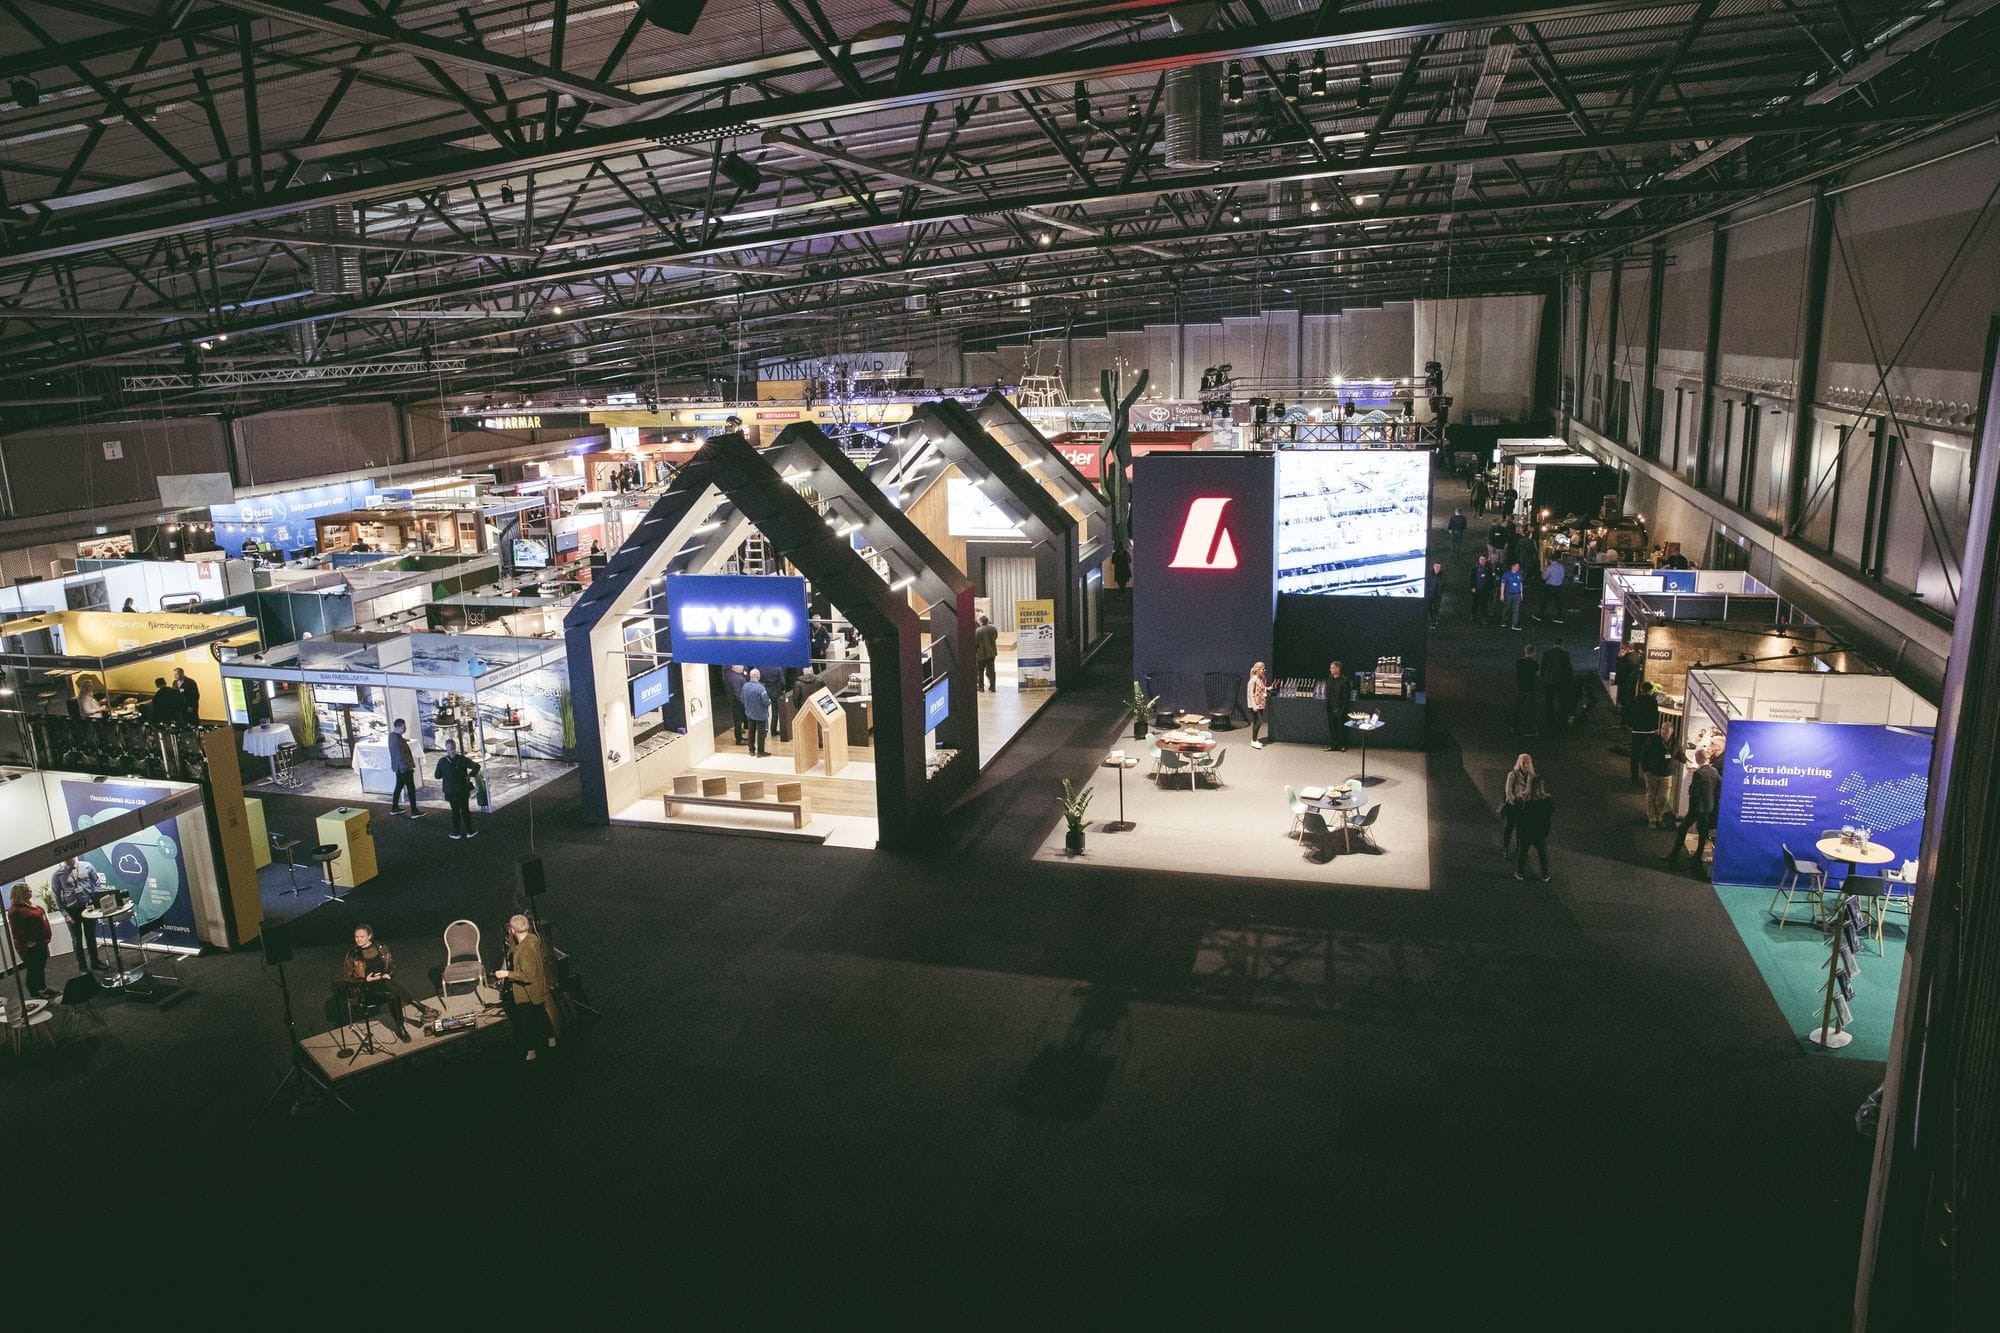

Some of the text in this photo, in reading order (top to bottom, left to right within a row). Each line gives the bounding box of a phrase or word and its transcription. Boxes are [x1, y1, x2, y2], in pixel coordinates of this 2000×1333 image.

[1175, 406, 1198, 415] Toyota
[254, 507, 273, 518] terra
[681, 606, 794, 636] BYKO
[641, 683, 663, 700] BYKO
[930, 696, 945, 714] BYKO
[1745, 764, 1833, 779] Græn iðnbylting
[1743, 775, 1789, 787] á Íslandi
